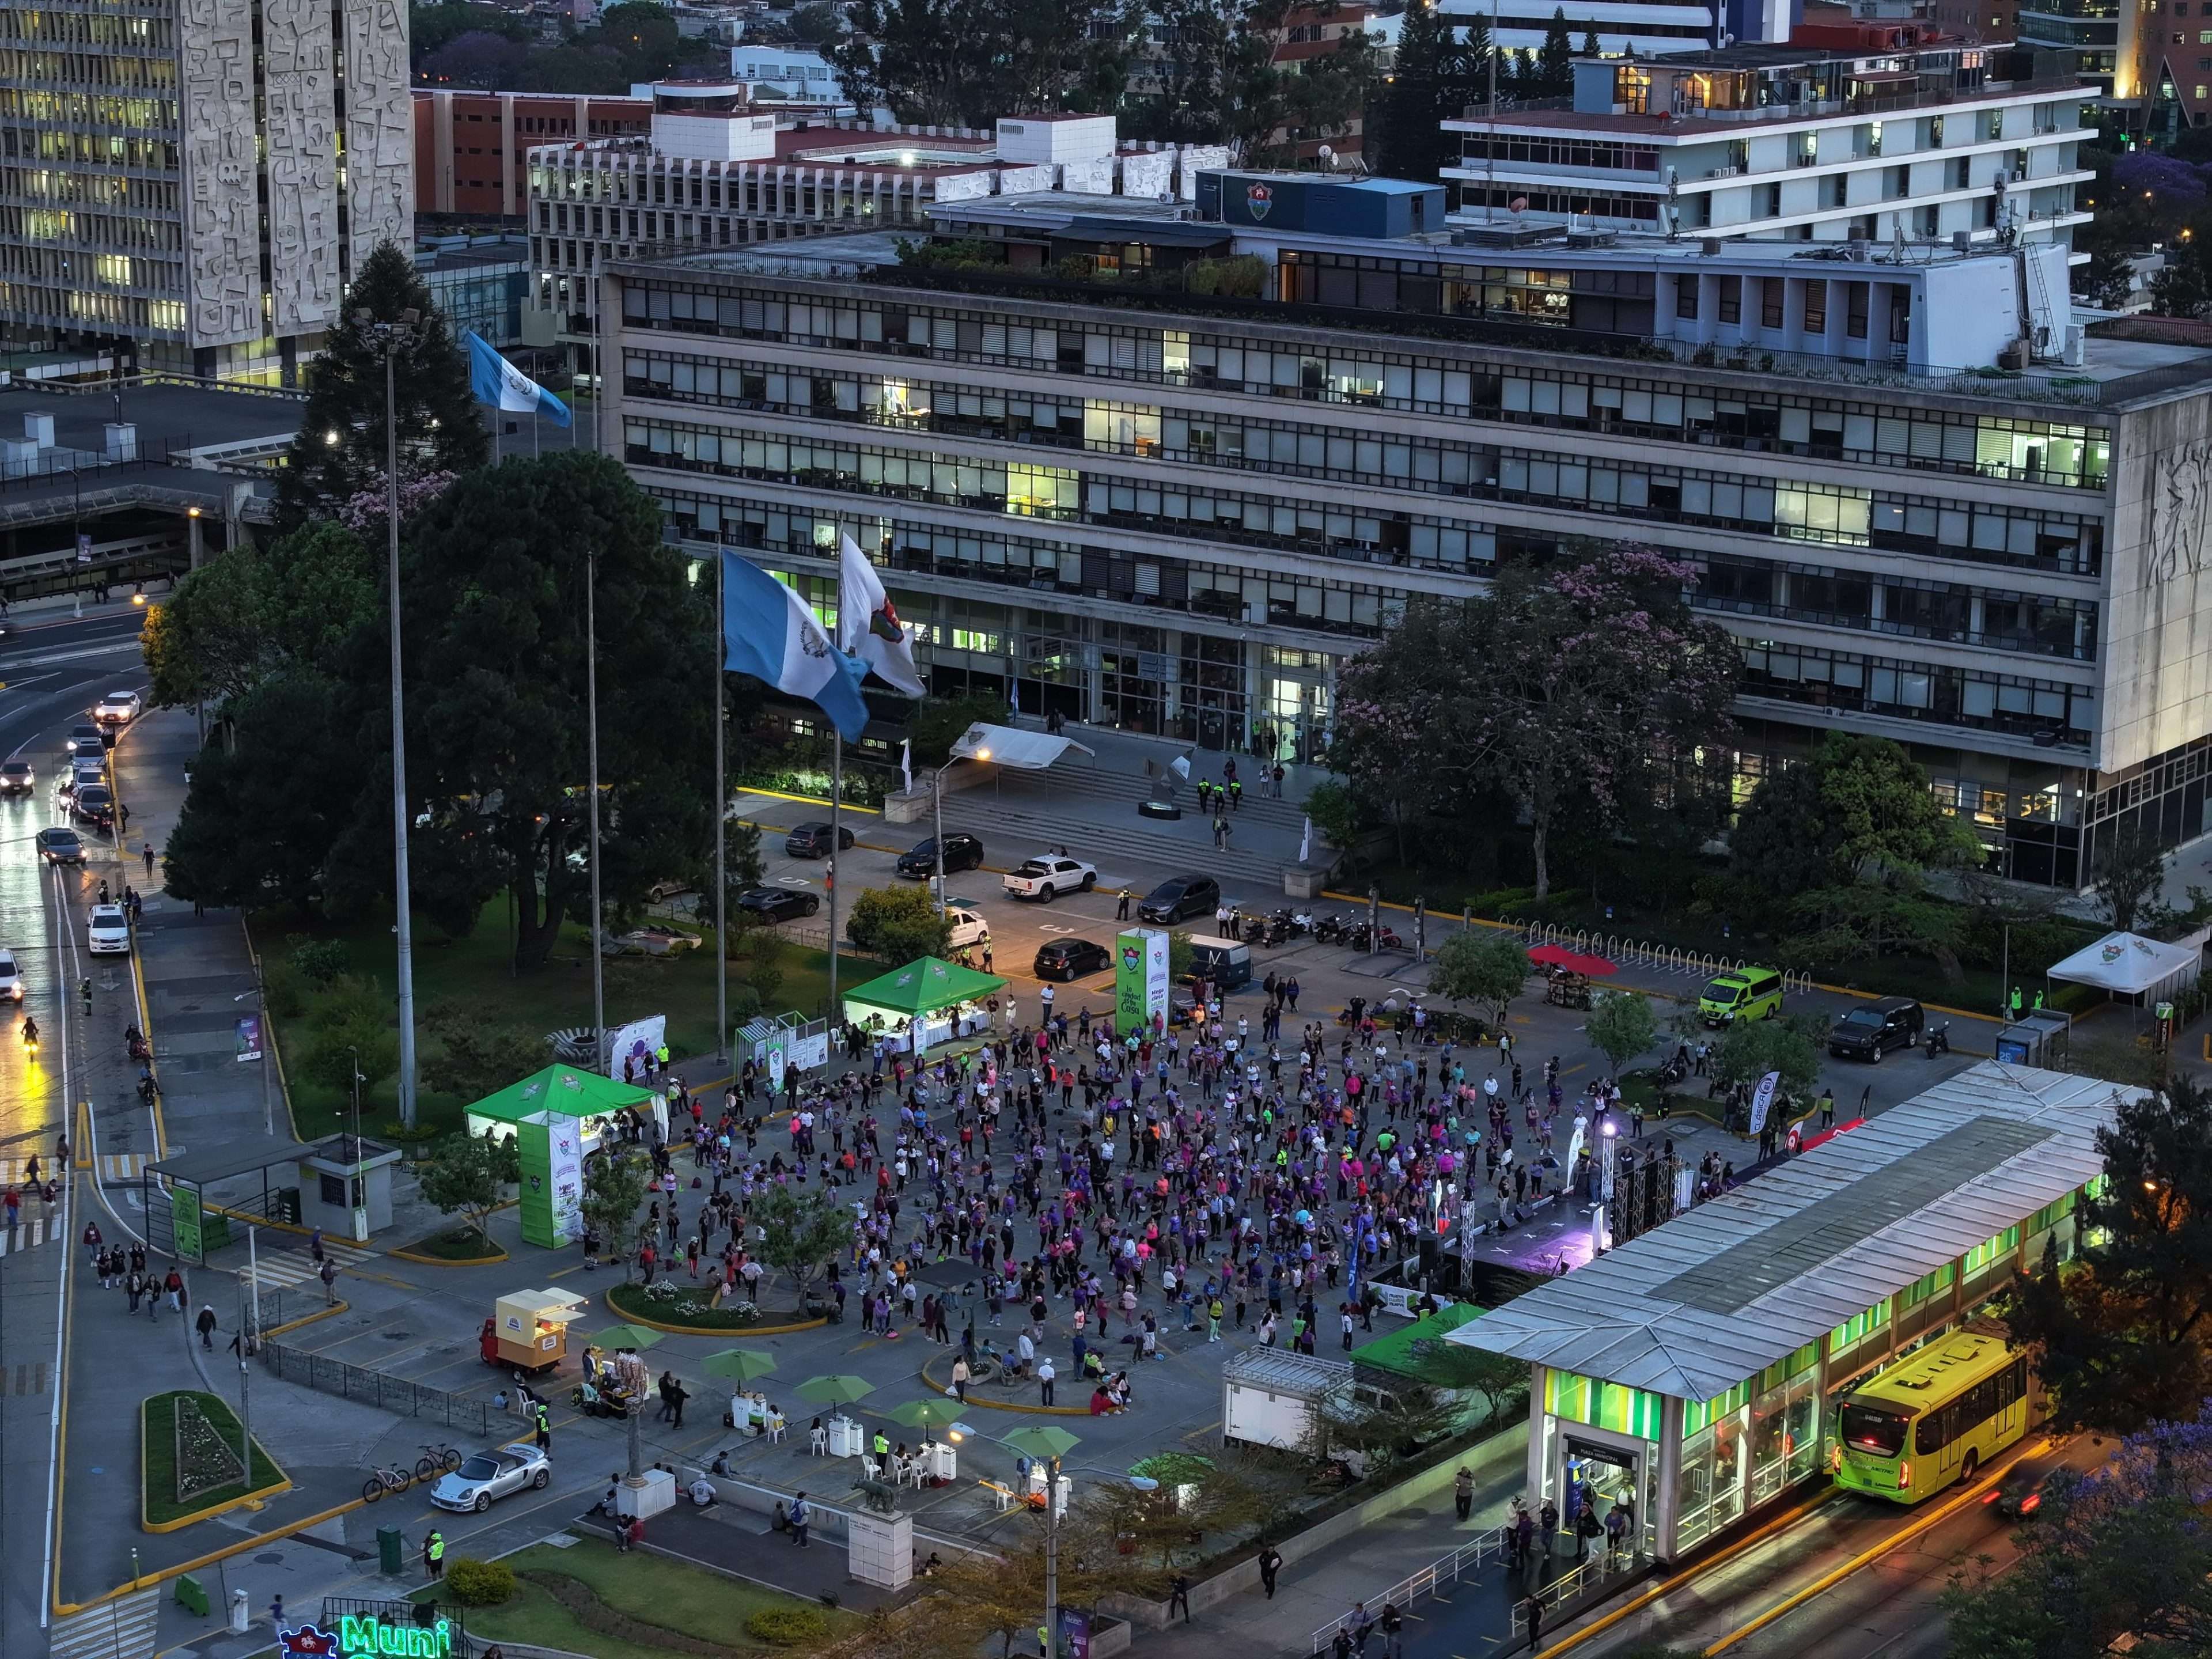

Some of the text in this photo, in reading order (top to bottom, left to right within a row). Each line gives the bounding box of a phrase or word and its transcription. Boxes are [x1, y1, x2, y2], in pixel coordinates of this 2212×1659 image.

[1121, 1001, 1139, 1014] Casa
[1755, 1094, 1766, 1131] CLÁSICA
[1580, 1448, 1594, 1456] PLAZA
[1594, 1452, 1619, 1463] MUNICIPAL
[341, 1615, 451, 1659] Muni
